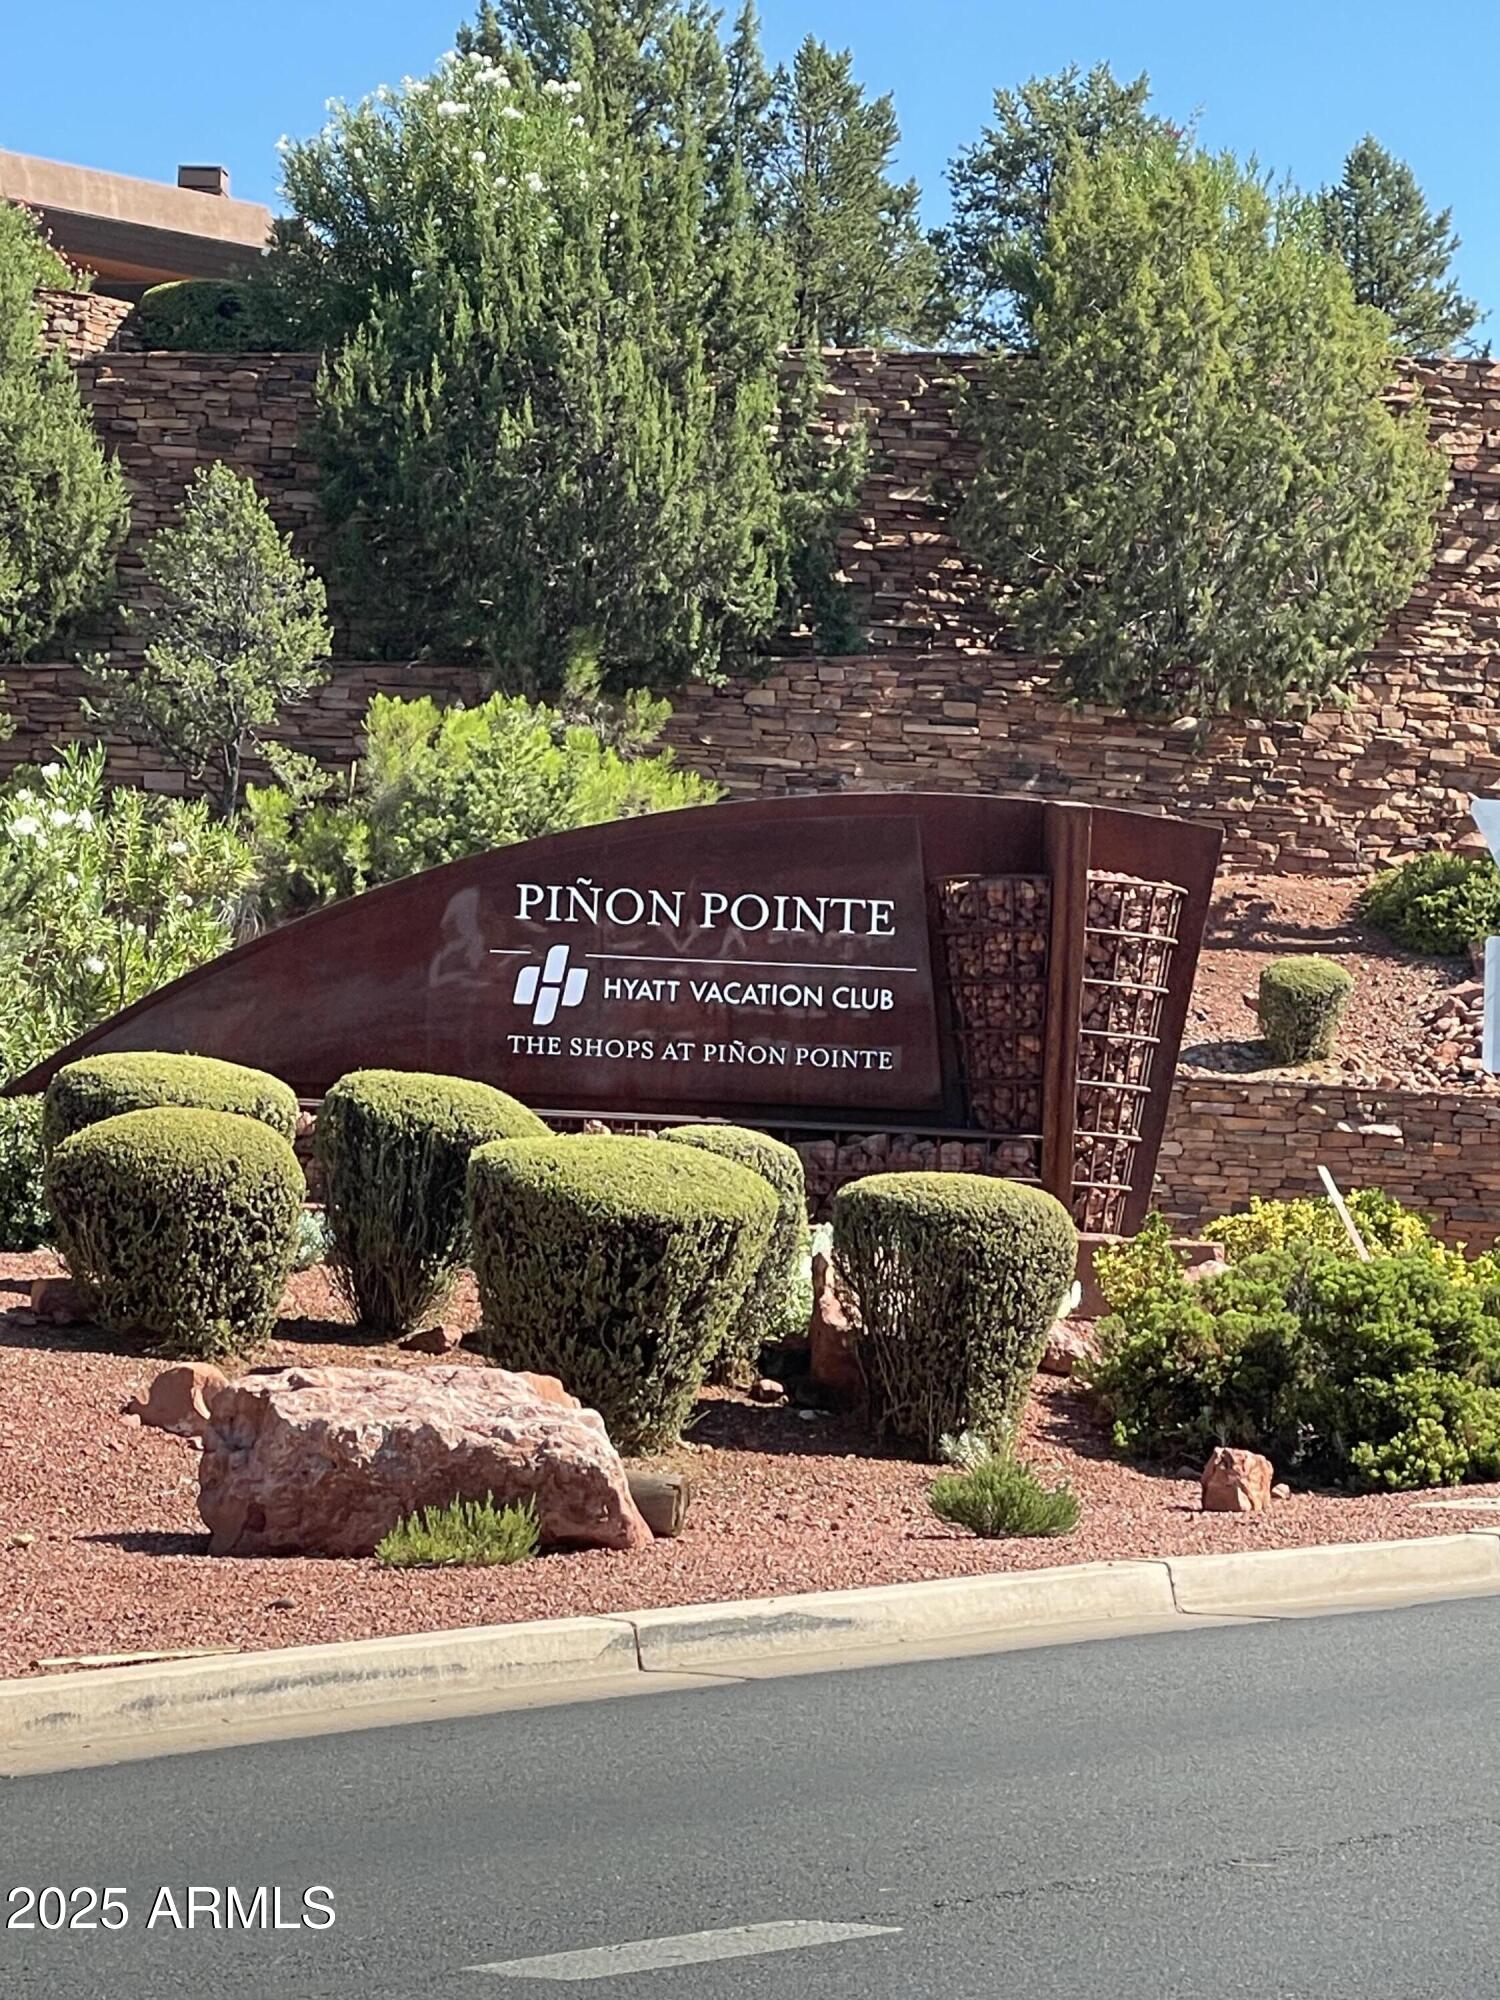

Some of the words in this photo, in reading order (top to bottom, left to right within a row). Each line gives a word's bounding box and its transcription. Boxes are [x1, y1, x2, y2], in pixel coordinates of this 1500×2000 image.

[515, 877, 686, 928] PIÑON
[701, 891, 896, 936] POINTE
[604, 977, 680, 1003] HYATT
[690, 981, 826, 1007] VACATION
[832, 986, 895, 1010] CLUB
[507, 1034, 561, 1056] THE
[569, 1037, 654, 1060] SHOPS
[661, 1041, 695, 1061] AT
[703, 1039, 786, 1066] PIÑON
[796, 1047, 893, 1070] POINTE
